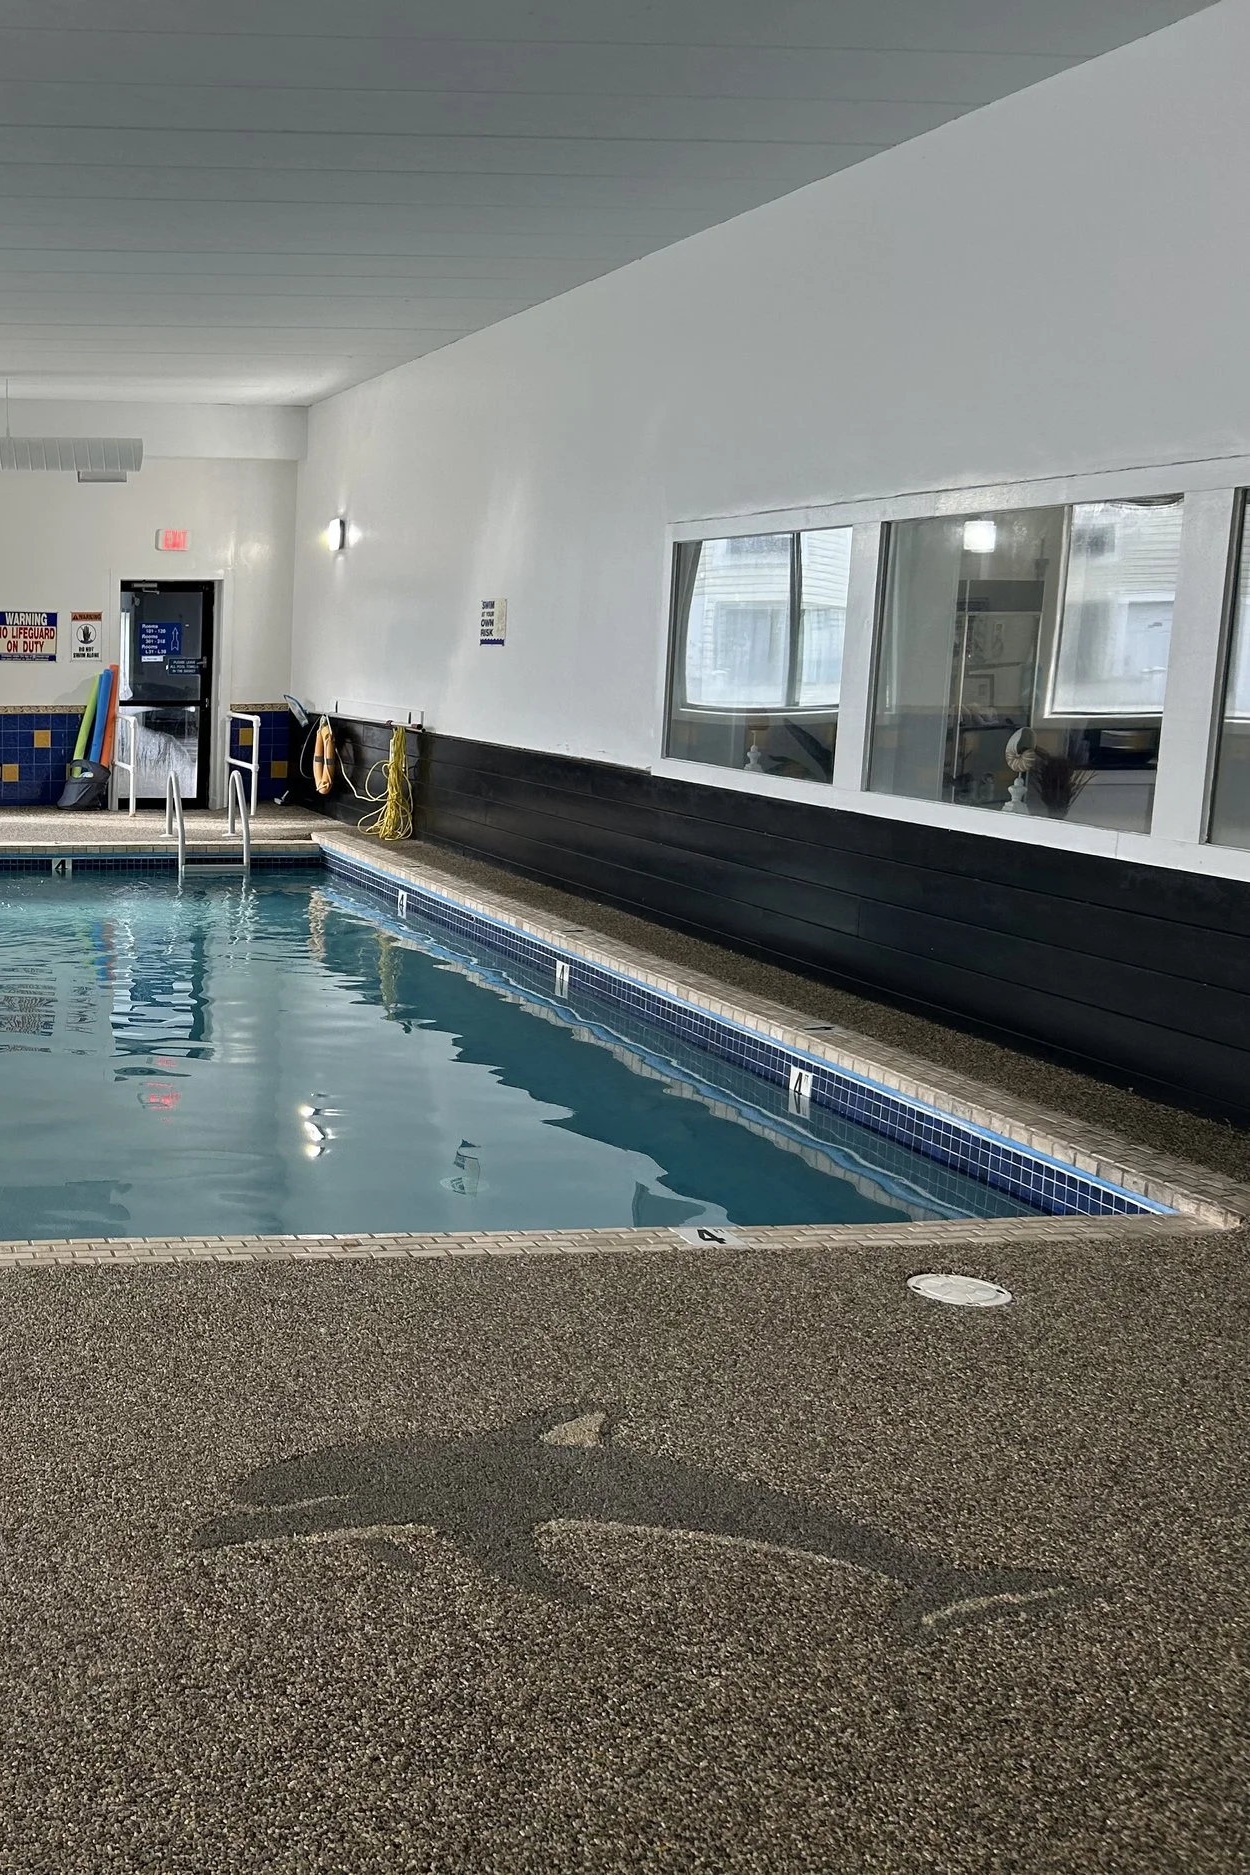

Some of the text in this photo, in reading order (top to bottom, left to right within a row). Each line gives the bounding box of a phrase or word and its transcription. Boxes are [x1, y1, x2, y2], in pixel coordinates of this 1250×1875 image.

[481, 600, 495, 609] SWIM
[5, 612, 48, 626] WARNING
[481, 619, 494, 627] OWN
[11, 627, 55, 639] LIFEGUARD
[480, 629, 493, 637] RISK
[6, 640, 44, 652] ON DUTY
[54, 859, 68, 870] 4
[794, 1071, 803, 1096] 4
[696, 1229, 726, 1244] 4
